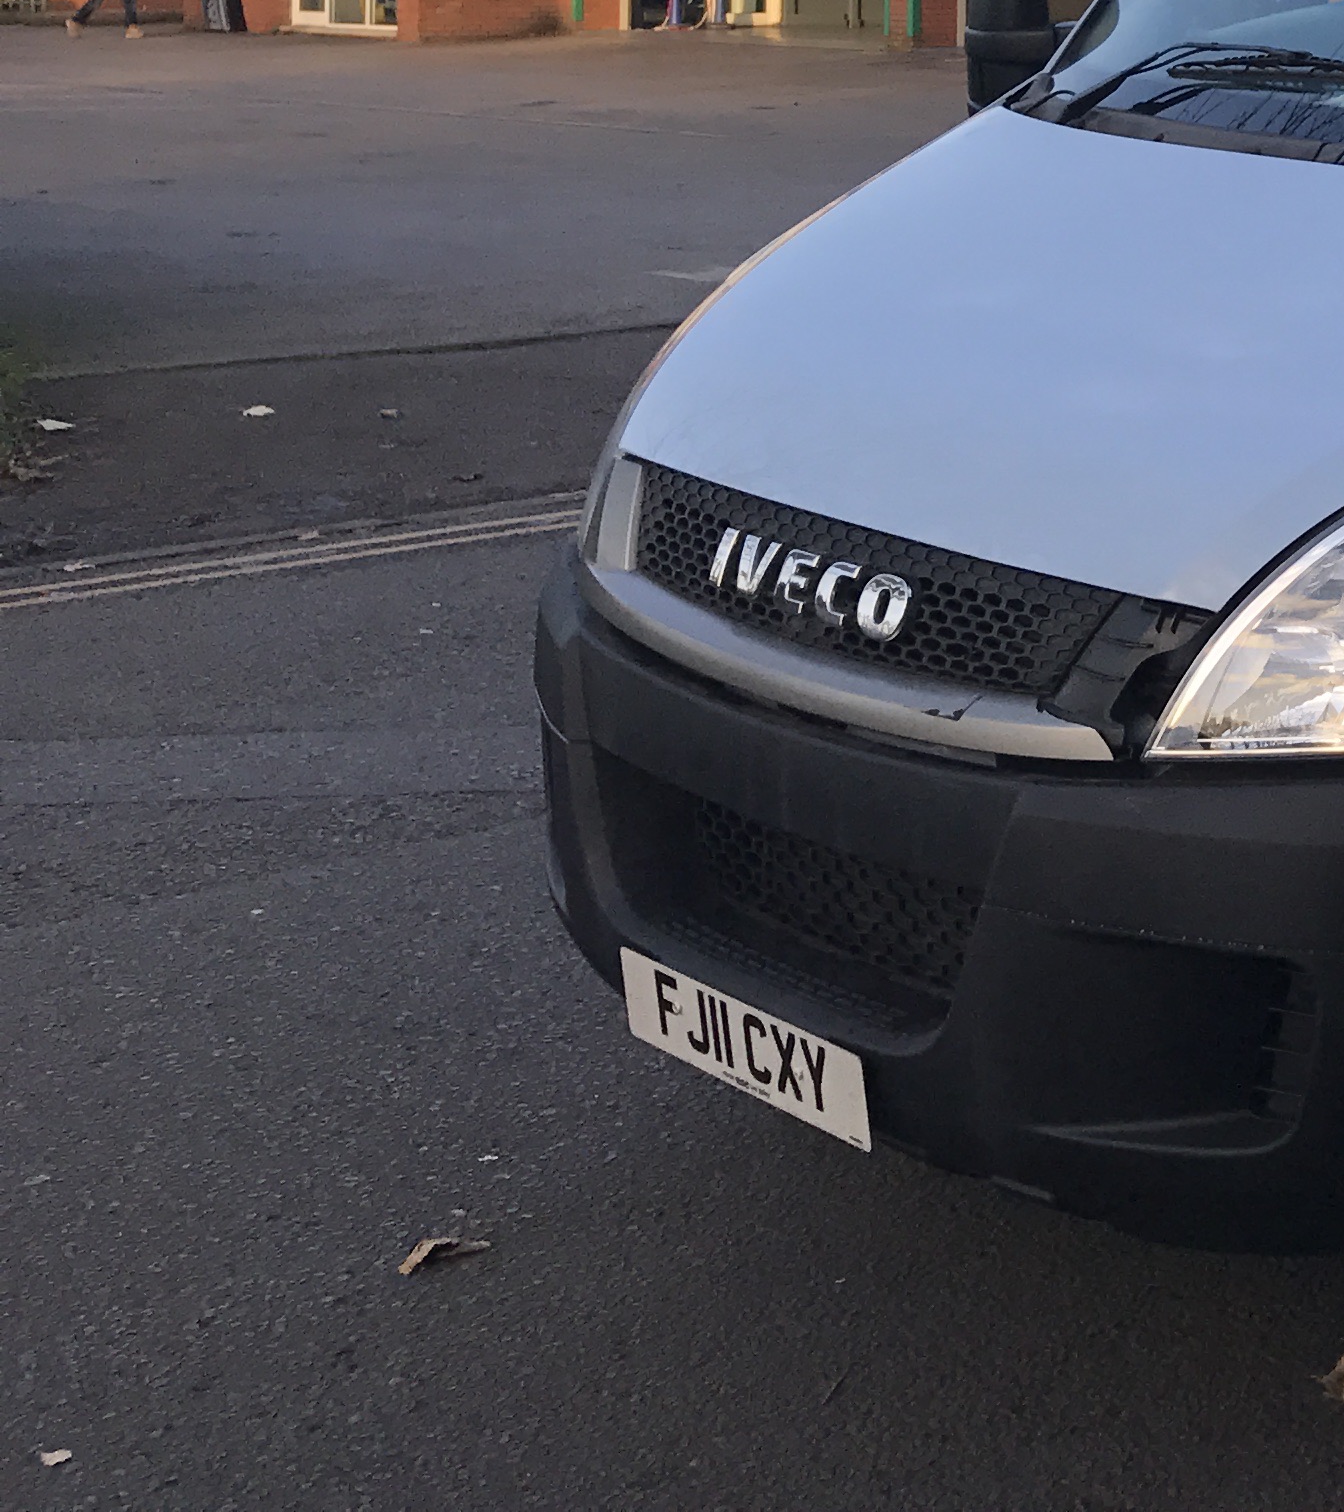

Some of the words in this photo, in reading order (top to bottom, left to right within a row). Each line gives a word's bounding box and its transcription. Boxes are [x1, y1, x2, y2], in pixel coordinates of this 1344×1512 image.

[708, 526, 913, 642] IVECO
[654, 968, 735, 1070] FJ11
[742, 1012, 826, 1113] CXY
